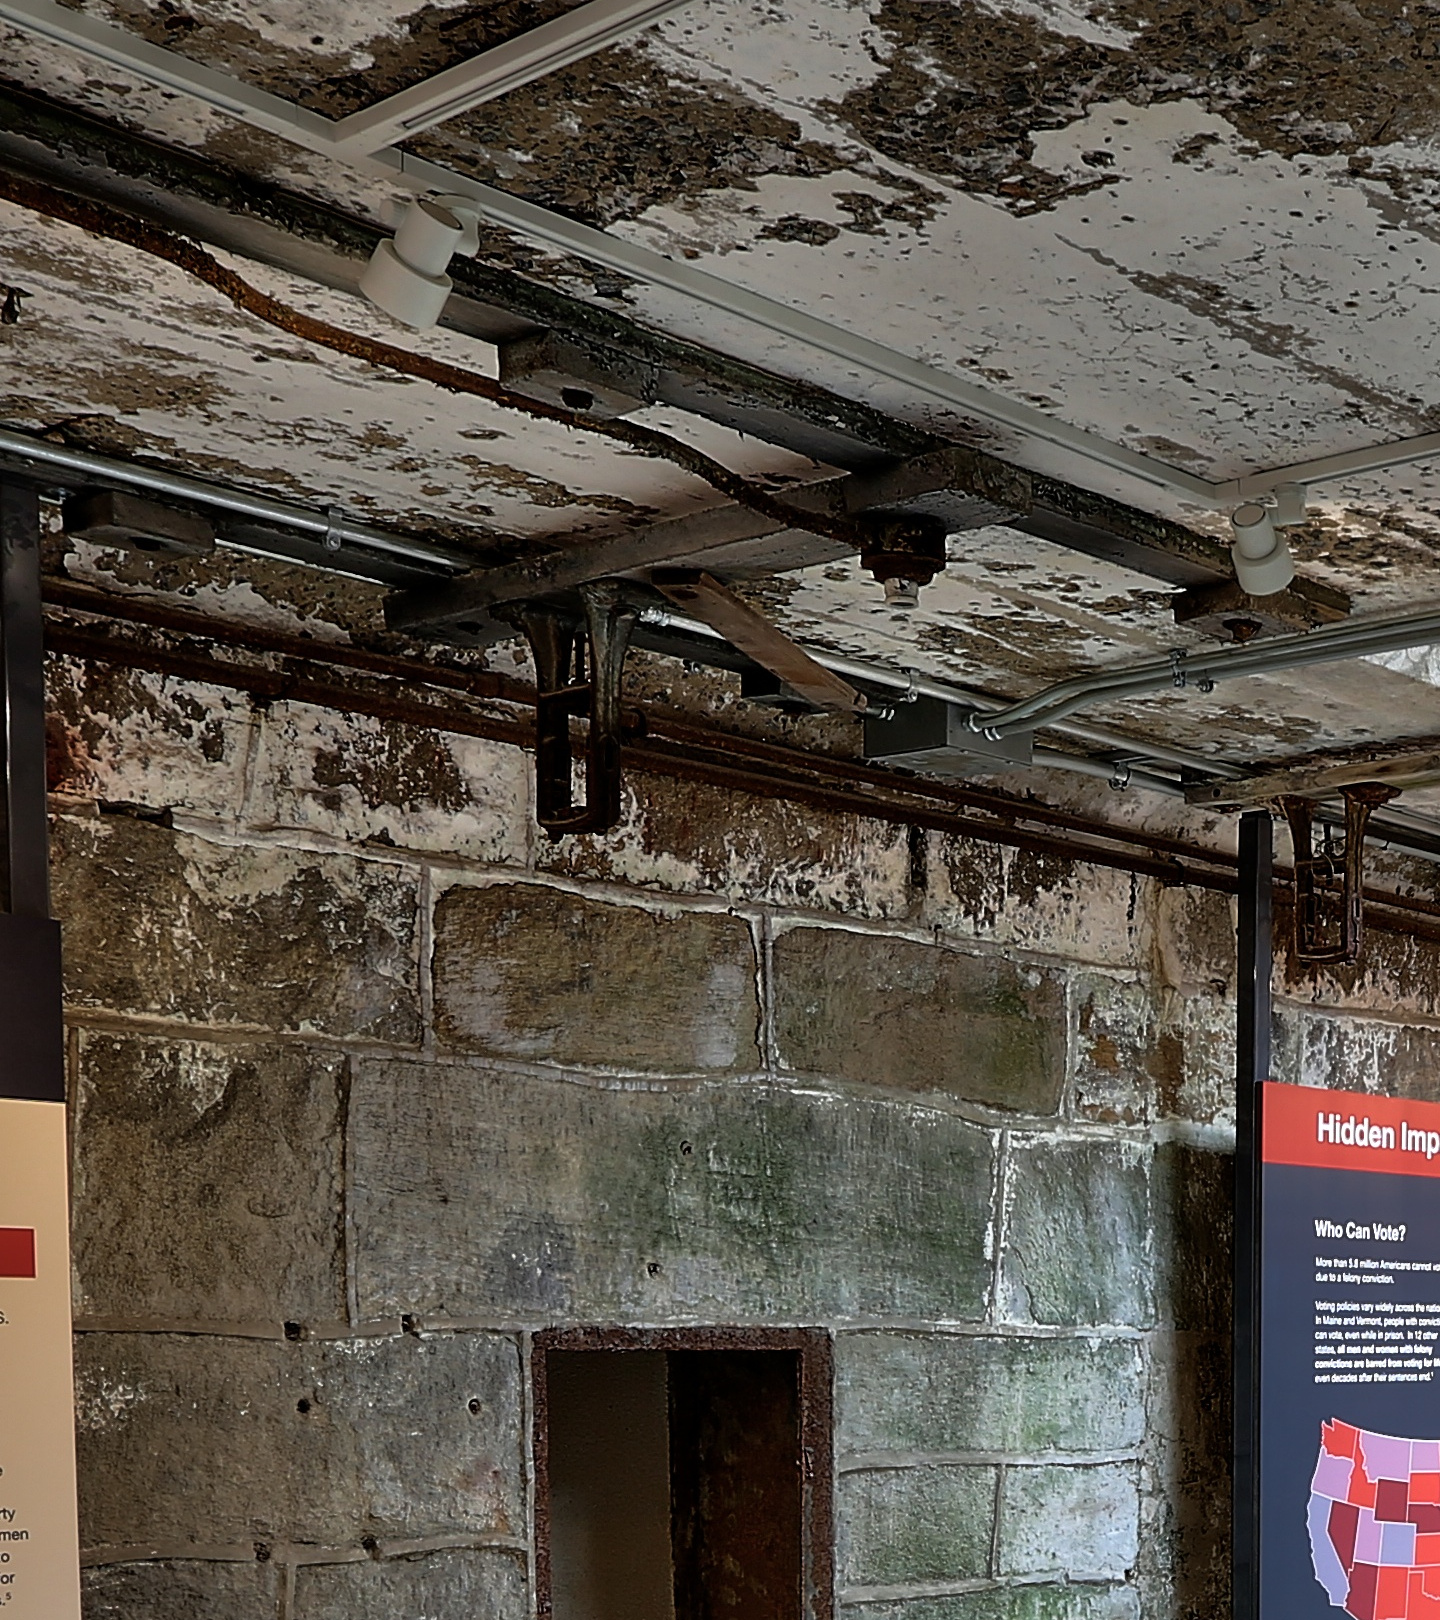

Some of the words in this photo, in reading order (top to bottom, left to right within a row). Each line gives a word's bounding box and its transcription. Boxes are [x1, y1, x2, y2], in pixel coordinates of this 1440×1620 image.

[1318, 1112, 1395, 1150] Hidden
[1314, 1220, 1344, 1238] Who
[1346, 1221, 1370, 1240] Can
[1372, 1222, 1406, 1242] Vote?
